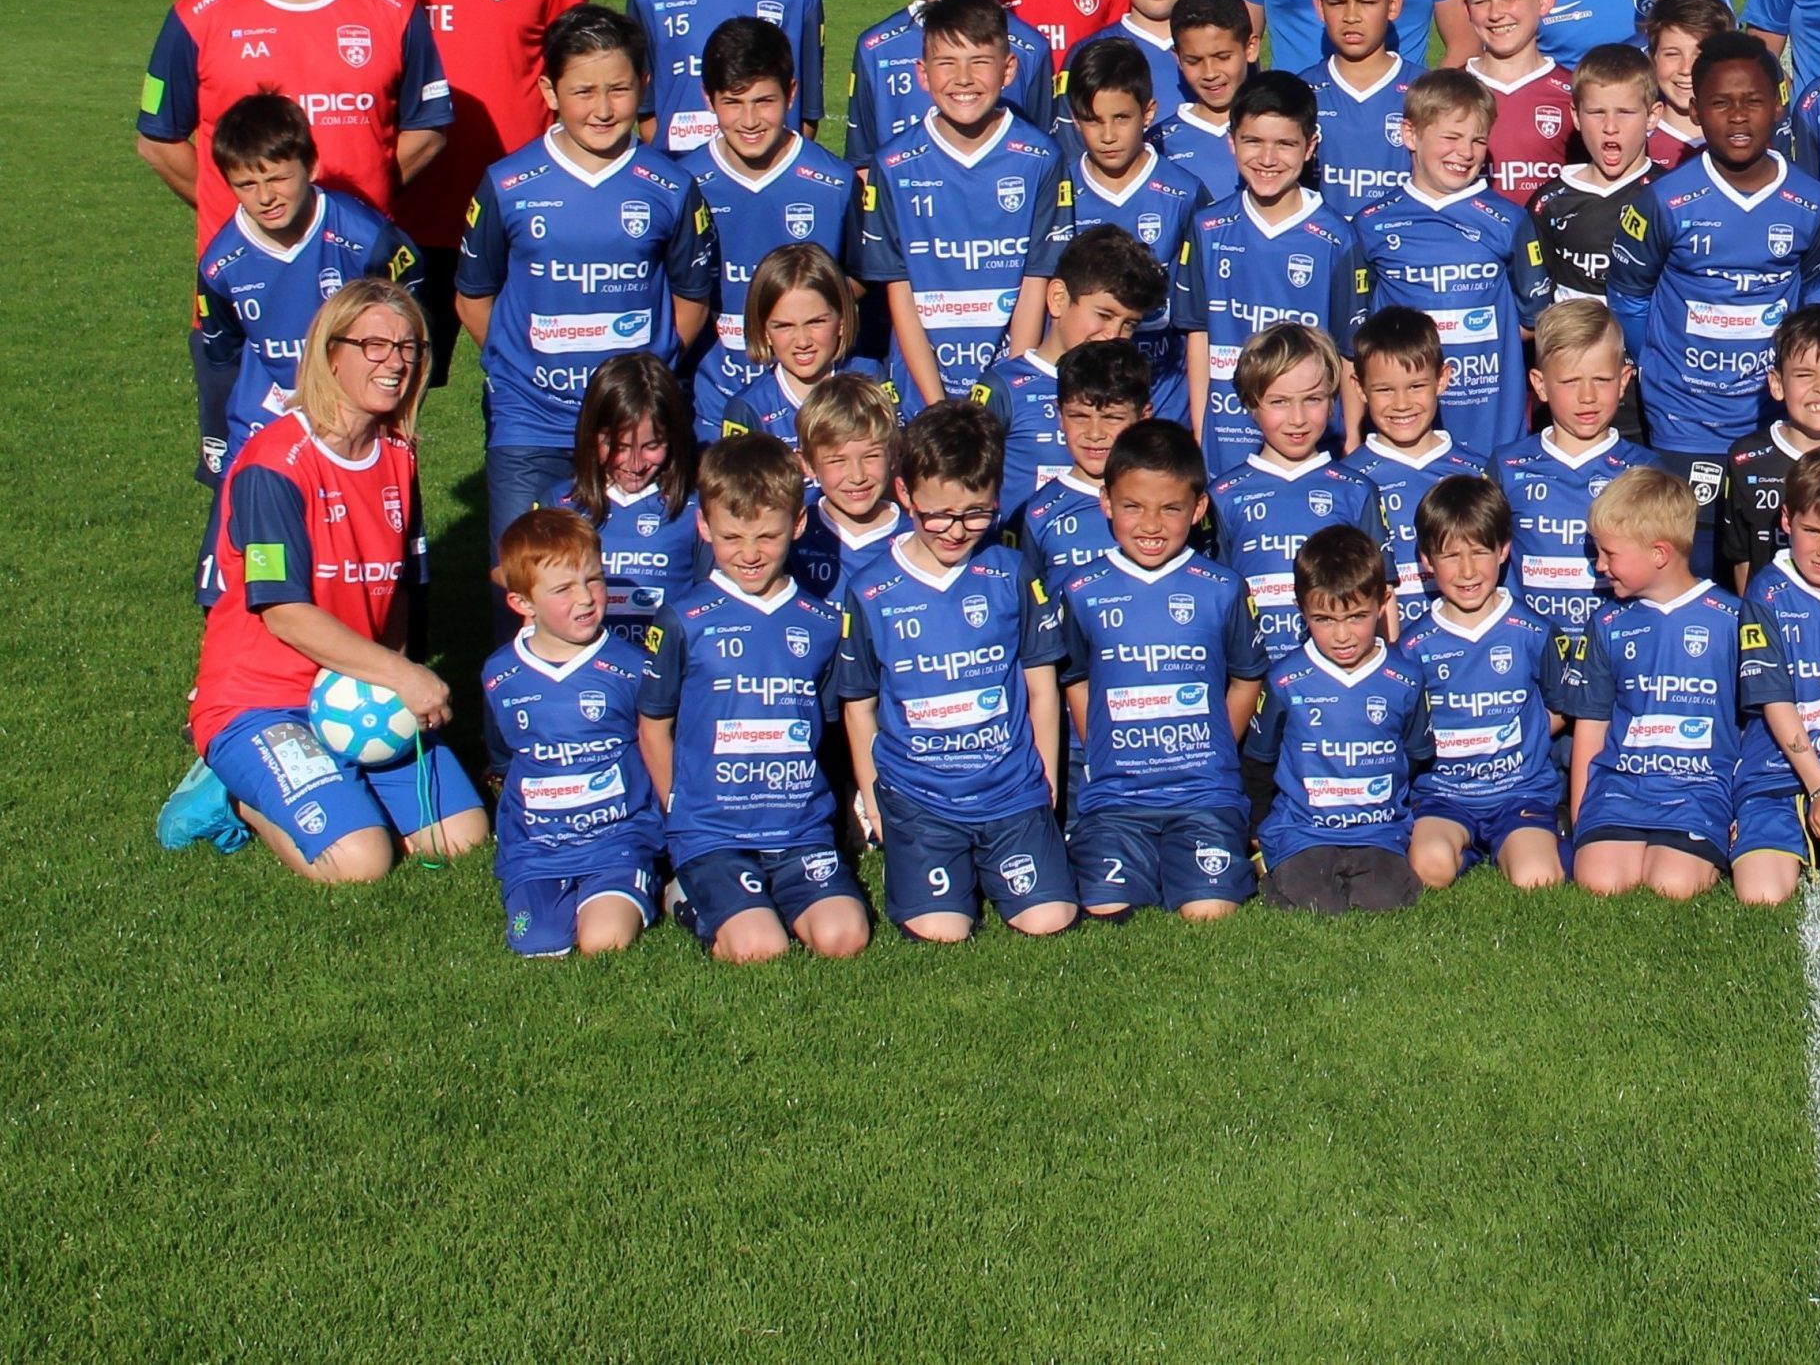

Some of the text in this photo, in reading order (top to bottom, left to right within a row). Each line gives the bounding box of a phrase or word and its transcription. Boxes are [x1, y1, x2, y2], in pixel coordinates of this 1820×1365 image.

[663, 13, 690, 37] 15
[241, 41, 270, 60] AA
[886, 72, 912, 96] 13
[503, 165, 550, 190] WOLF
[911, 195, 934, 218] 11
[1668, 187, 1711, 207] WOLF
[529, 216, 547, 240] 6
[1386, 234, 1401, 251] 9
[1689, 234, 1712, 255] 11
[551, 260, 650, 294] typico
[1219, 257, 1231, 279] 8
[1404, 262, 1499, 293] typico
[233, 298, 261, 322] 10
[1230, 298, 1320, 333] typico
[1464, 374, 1500, 386] Partner
[1467, 387, 1500, 397] Vorsorgen
[1043, 403, 1055, 419] 3
[1524, 483, 1548, 502] 10
[1755, 490, 1779, 509] 20
[1243, 502, 1267, 522] 10
[1053, 516, 1078, 535] 10
[807, 562, 831, 581] 10
[1072, 569, 1110, 588] WOLF
[1188, 566, 1230, 583] WOLF
[893, 618, 921, 640] 10
[1099, 608, 1123, 629] 10
[1507, 618, 1542, 632] WOLF
[1781, 624, 1801, 644] 11
[715, 638, 744, 658] 10
[1118, 643, 1207, 672] typico
[1624, 641, 1637, 661] 8
[917, 643, 1005, 681] typico
[1438, 664, 1450, 680] 6
[1280, 667, 1313, 685] WOLF
[1638, 674, 1717, 702] typico
[1448, 689, 1527, 717] typico
[517, 710, 530, 730] 9
[1309, 708, 1322, 726] 2
[1112, 722, 1210, 750] SCHORM
[1322, 739, 1397, 766] typico
[715, 760, 816, 784] SCHORM
[1103, 857, 1126, 884] 2
[739, 871, 763, 893] 6
[928, 867, 950, 896] 9
